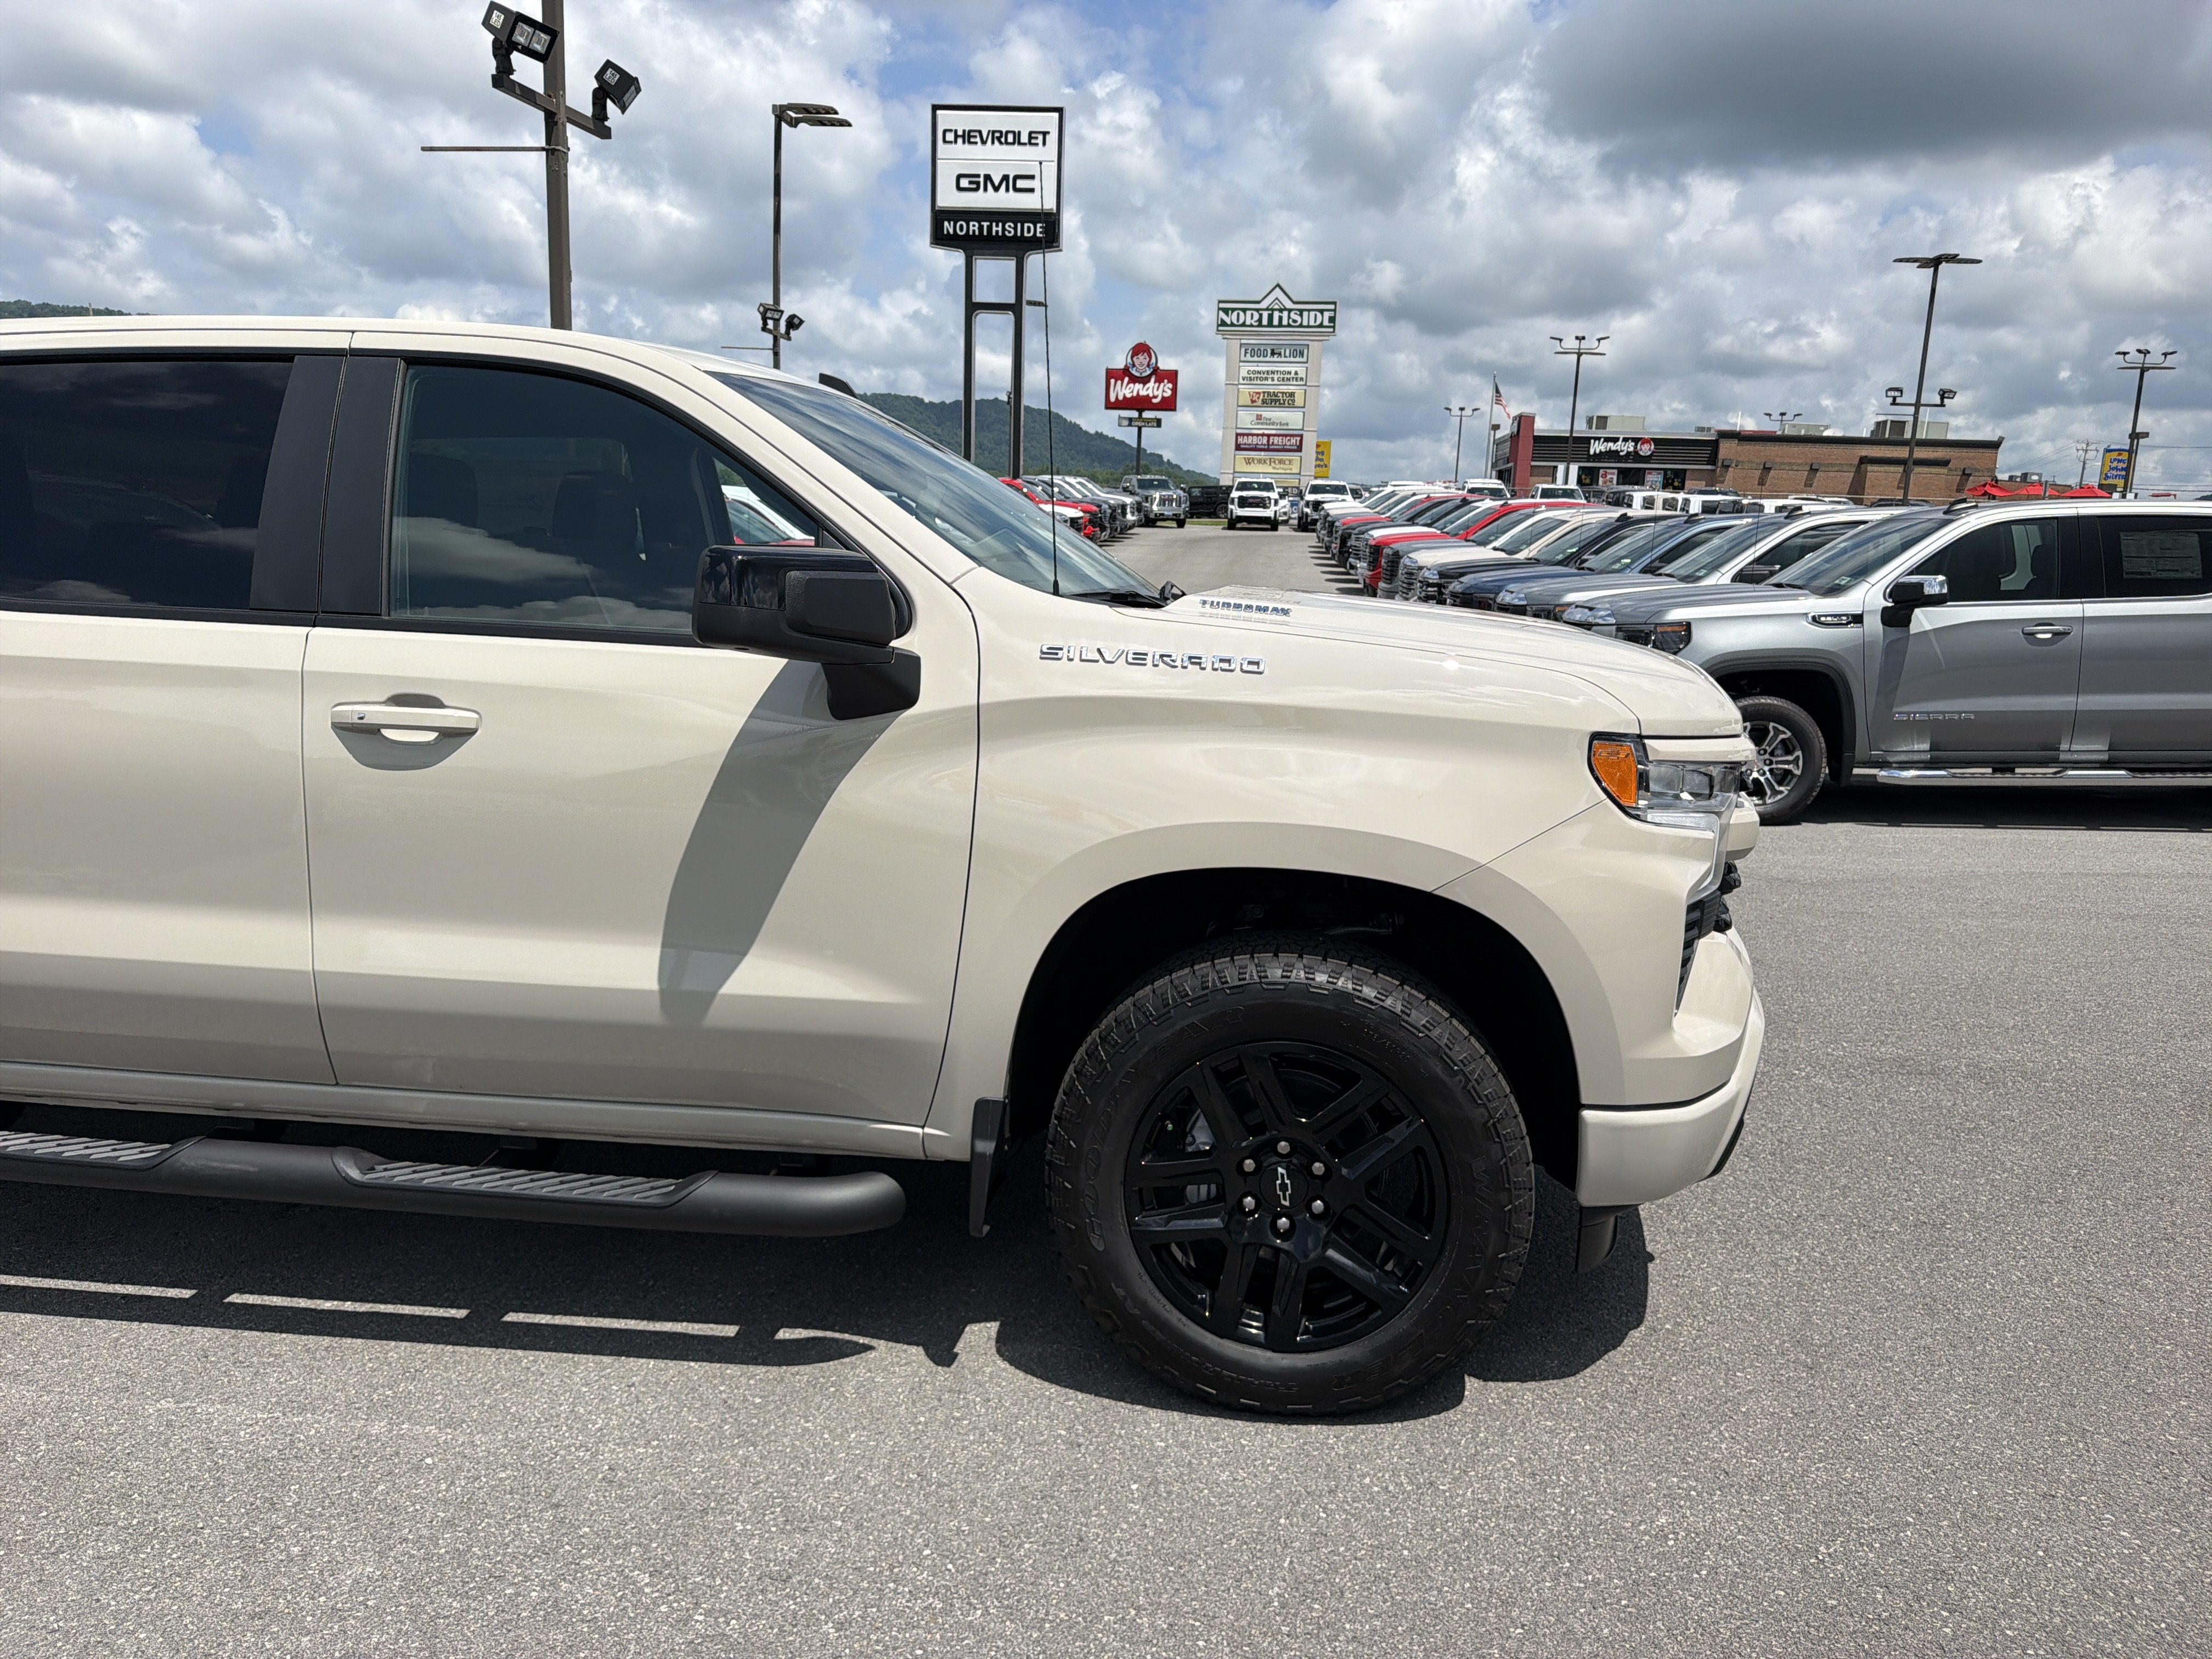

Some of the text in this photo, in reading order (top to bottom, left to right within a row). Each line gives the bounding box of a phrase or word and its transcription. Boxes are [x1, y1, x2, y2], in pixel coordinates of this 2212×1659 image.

[491, 17, 500, 27] LED
[605, 74, 615, 83] LED
[942, 128, 1050, 146] CHEVROLET
[955, 173, 1035, 193] GMC
[943, 221, 1046, 238] NORTHSIDE
[1218, 310, 1335, 326] NORTHSIDE
[1244, 348, 1305, 359] FOOD LION
[1109, 375, 1172, 403] Wendy's
[1237, 436, 1301, 445] HARBOR FREIGHT
[1589, 436, 1635, 456] Wendy's
[1199, 599, 1293, 617] TURBOMAX
[1039, 644, 1266, 674] SILVERADO
[1084, 1005, 1245, 1251] GOODYEAR
